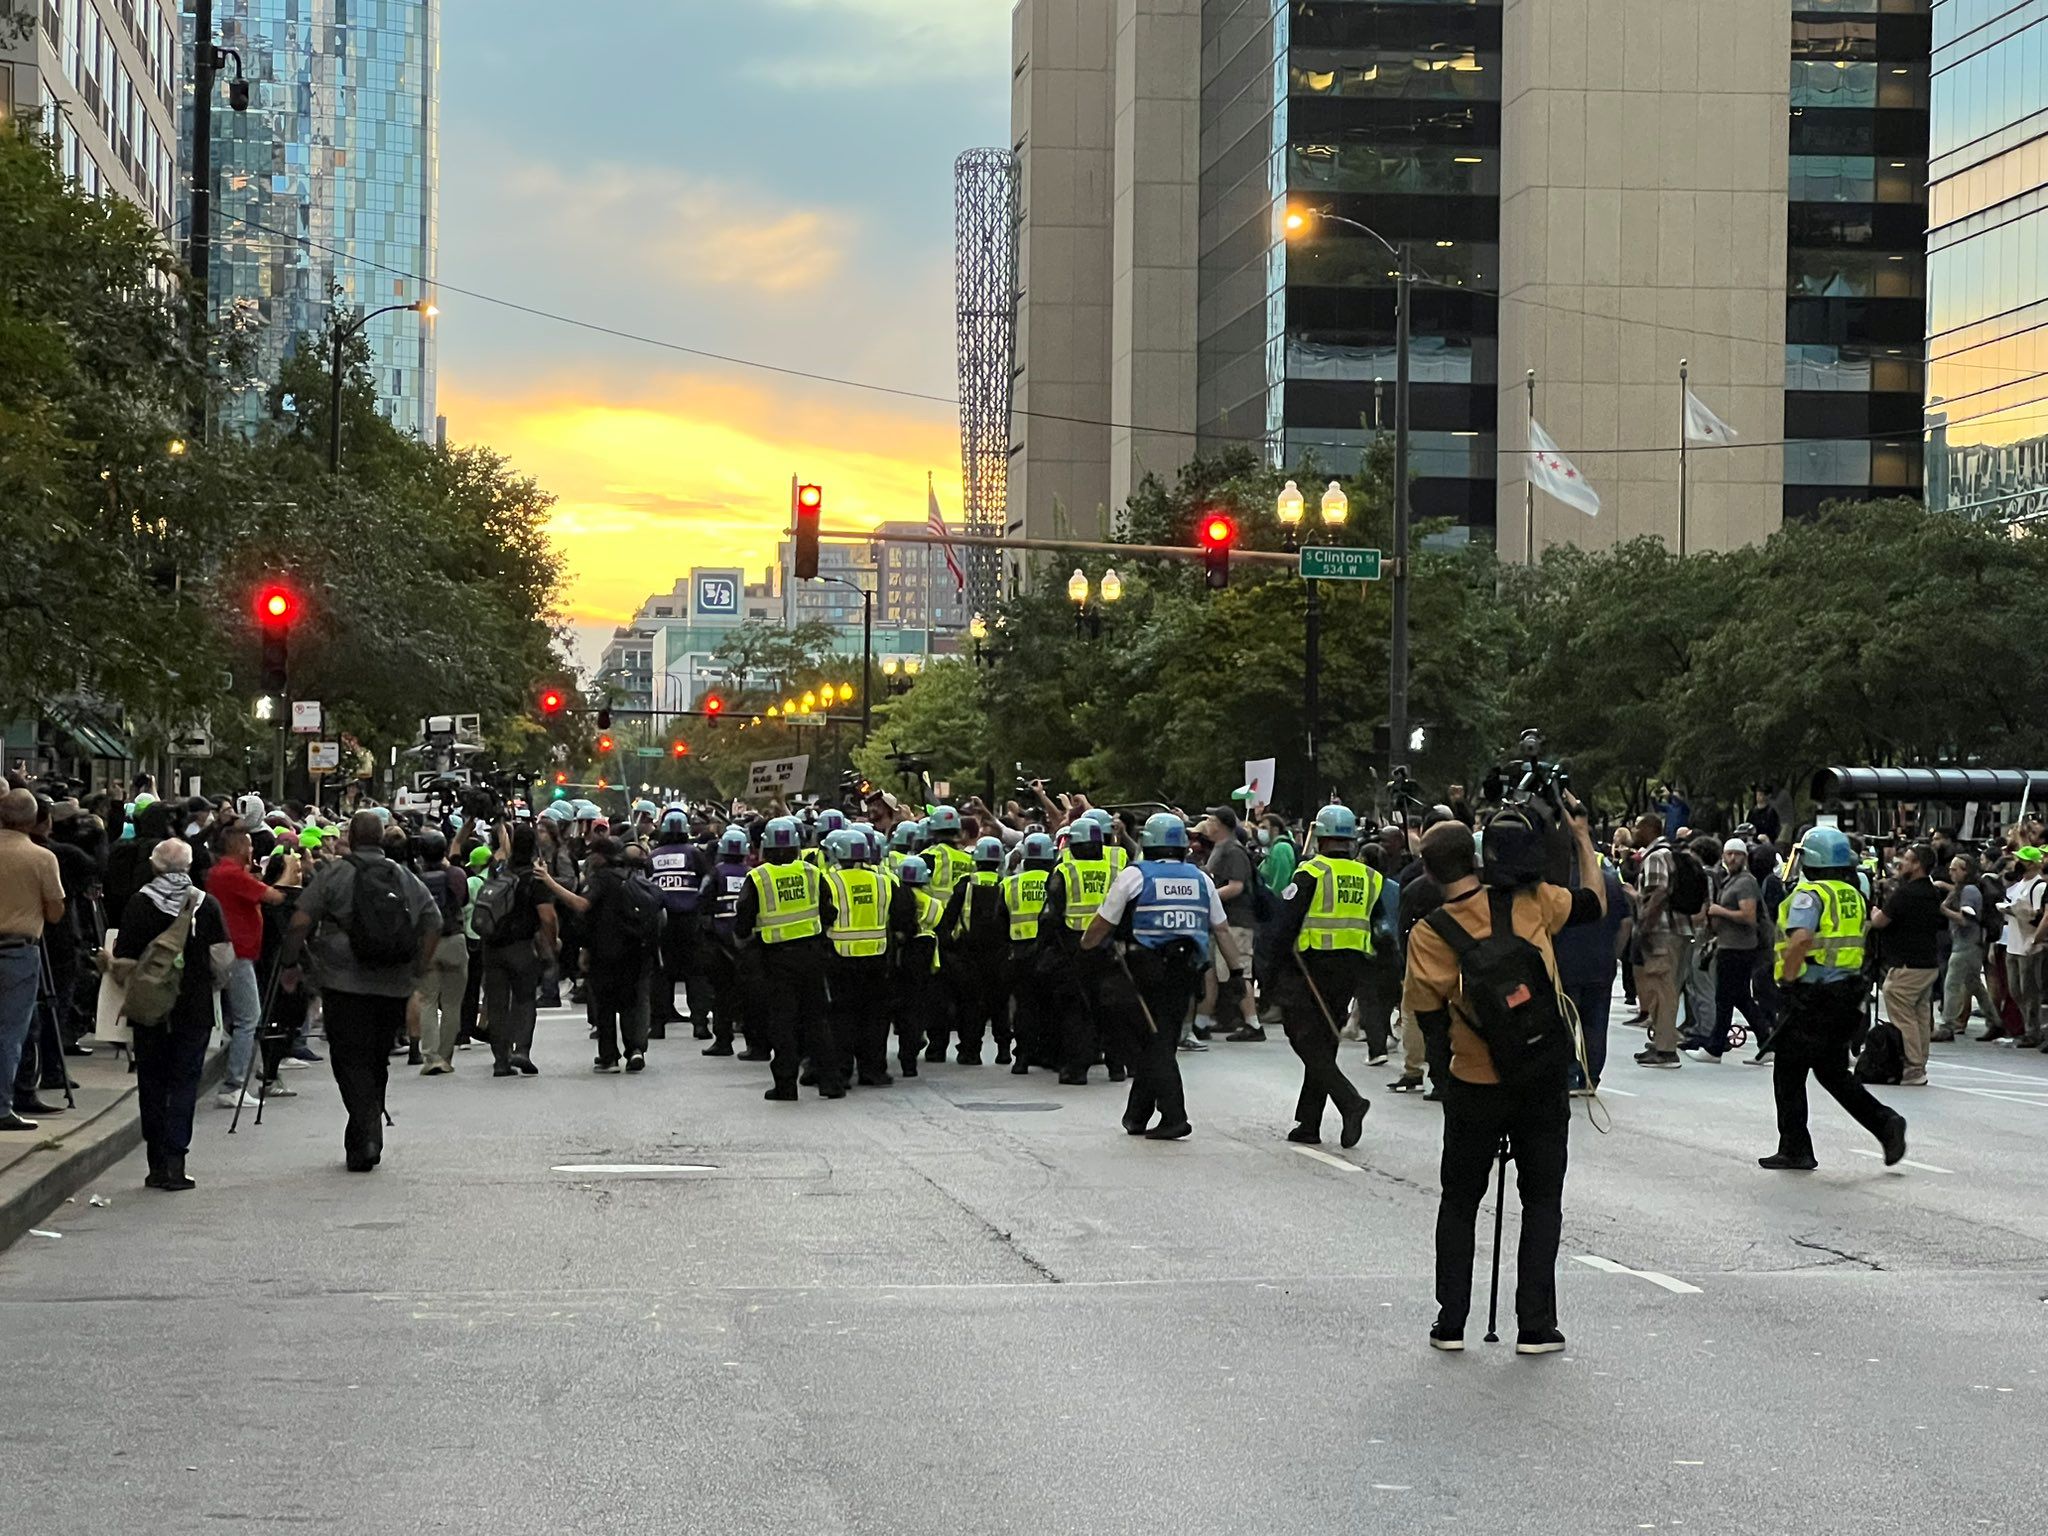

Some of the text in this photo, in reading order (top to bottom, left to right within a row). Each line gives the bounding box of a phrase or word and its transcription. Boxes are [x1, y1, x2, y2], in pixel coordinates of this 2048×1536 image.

[1306, 551, 1375, 563] S Clinton St
[1323, 565, 1357, 575] 534 W
[753, 775, 772, 783] HAS
[659, 876, 682, 887] CPD
[776, 875, 804, 890] CHICAGO
[1082, 871, 1106, 882] CHICAGO
[1337, 875, 1364, 890] CHICAGO
[1084, 882, 1105, 894] POLICE
[1164, 885, 1192, 896] CA105
[778, 888, 805, 903] POLICE
[1338, 890, 1363, 905] POLICE
[1163, 911, 1195, 928] CPD
